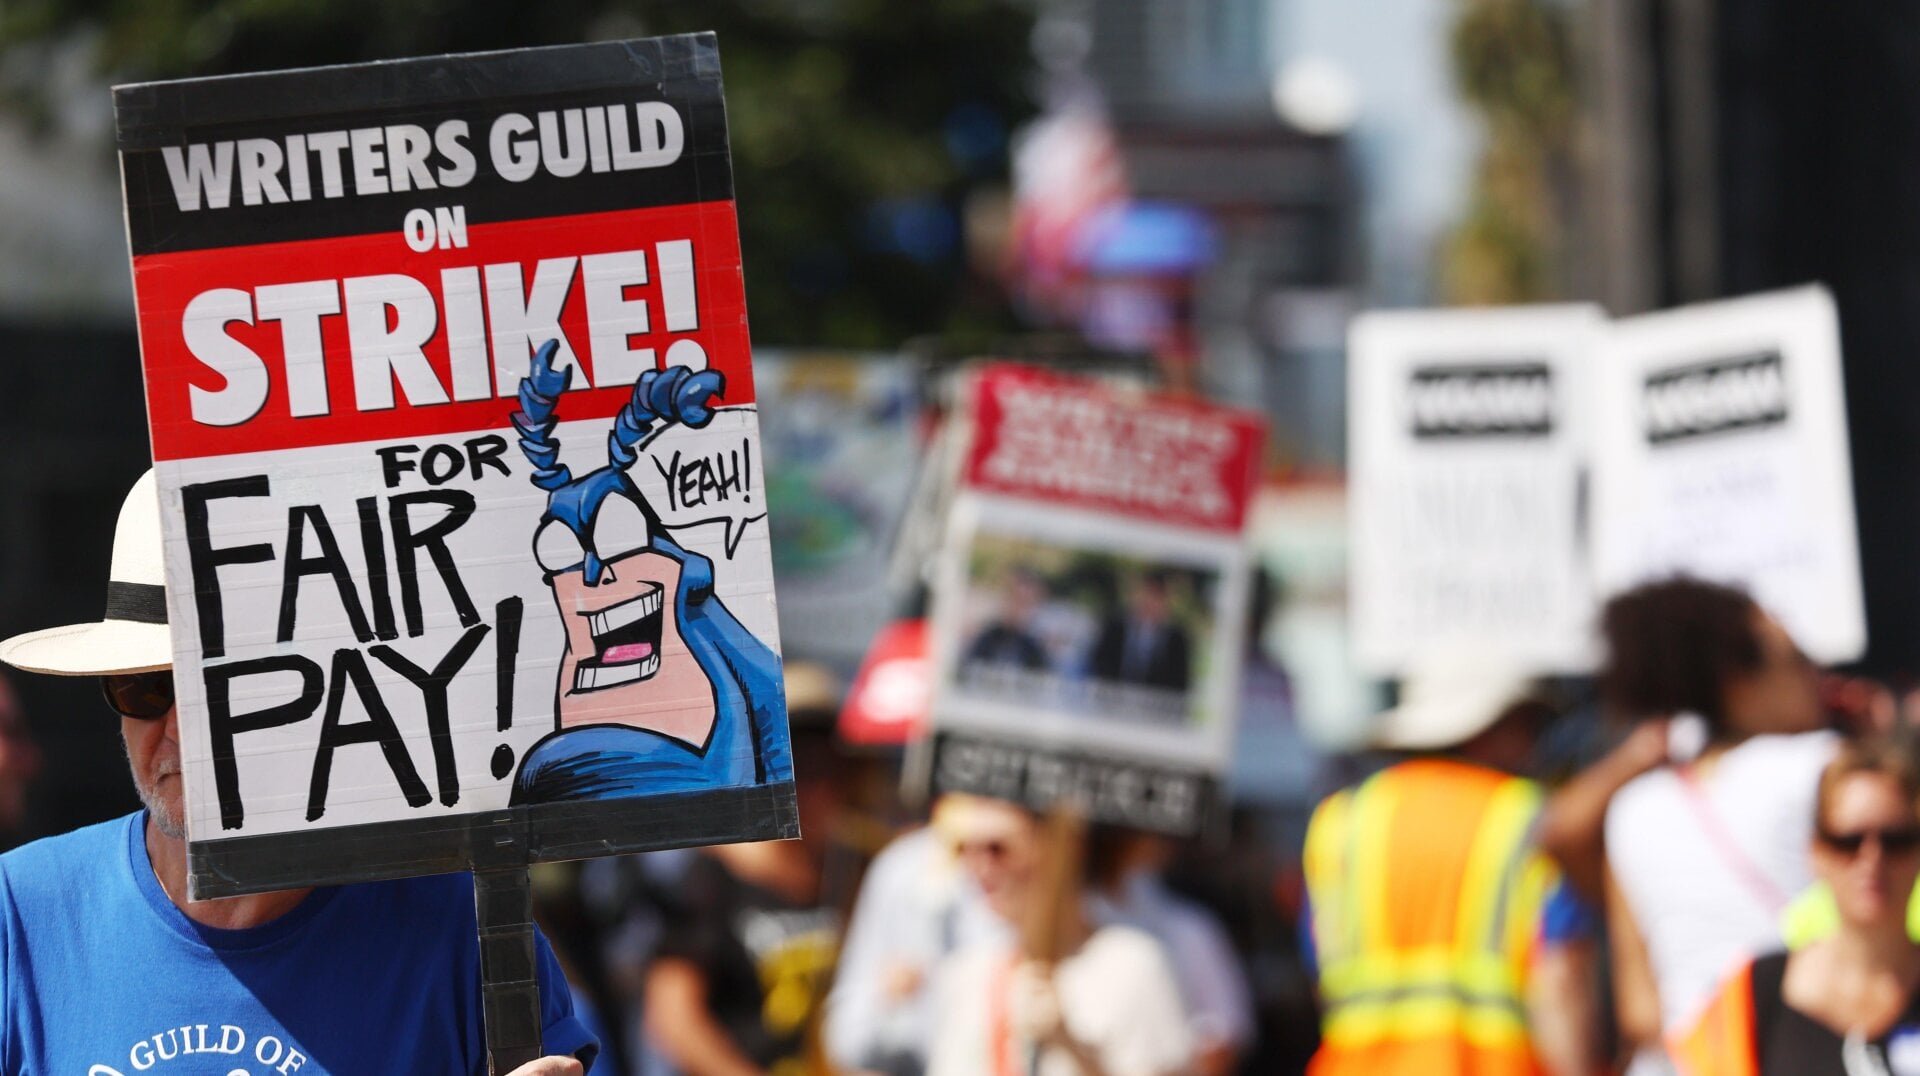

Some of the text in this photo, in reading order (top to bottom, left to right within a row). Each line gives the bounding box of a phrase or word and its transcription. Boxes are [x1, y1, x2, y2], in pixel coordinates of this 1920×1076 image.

[161, 101, 685, 212] WRITERS GUILD
[403, 205, 469, 252] ON
[181, 238, 709, 427] STRIKE!
[375, 434, 510, 488] FOR
[652, 437, 753, 512] YEAH!
[181, 474, 482, 660] FAIR
[203, 595, 524, 831] PAY!
[129, 1024, 307, 1076] GUILD OF
